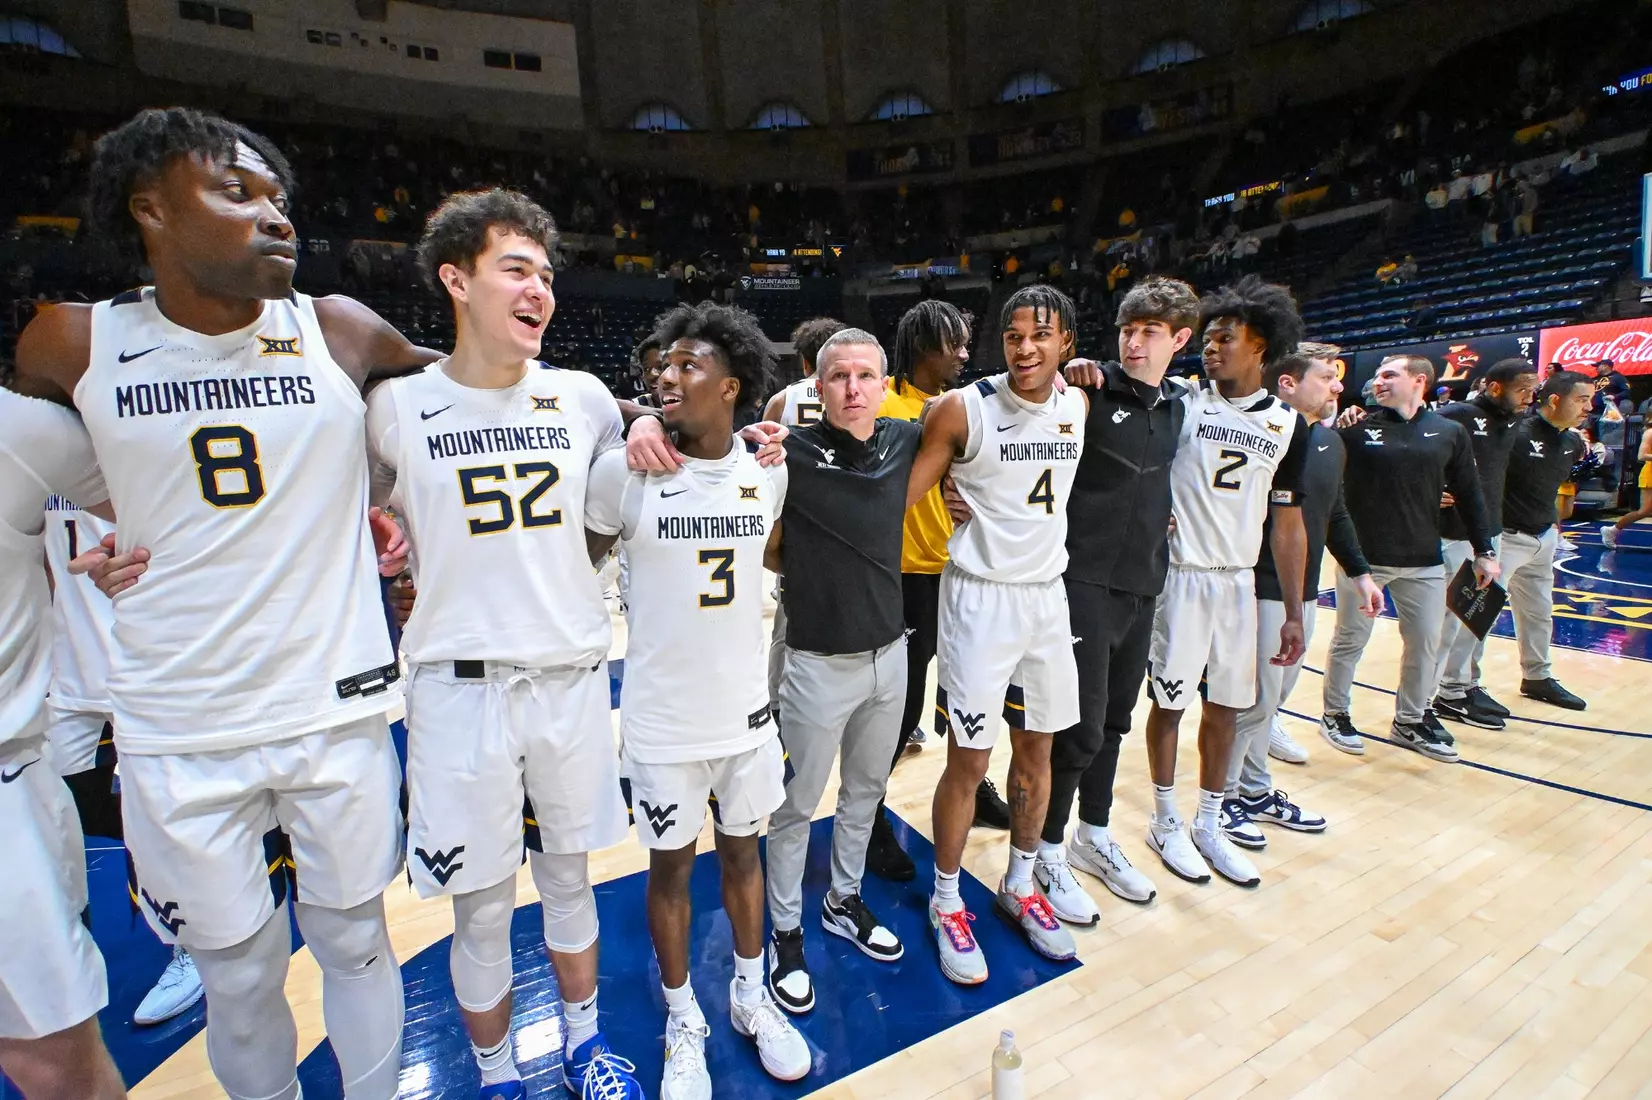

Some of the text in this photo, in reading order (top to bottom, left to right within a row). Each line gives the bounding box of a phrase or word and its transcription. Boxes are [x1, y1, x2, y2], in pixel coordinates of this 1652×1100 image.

[116, 376, 316, 418] MOUNTAINEERS
[427, 426, 571, 460] MOUNTAINEERS
[1000, 442, 1078, 462] MOUNTAINEERS
[1196, 423, 1279, 459] MOUNTAINEERS
[188, 424, 267, 510] 8
[1213, 448, 1249, 491] 2
[456, 461, 563, 538] 52
[1027, 467, 1055, 515] 4
[658, 515, 765, 539] MOUNTAINEERS
[697, 548, 735, 609] 3
